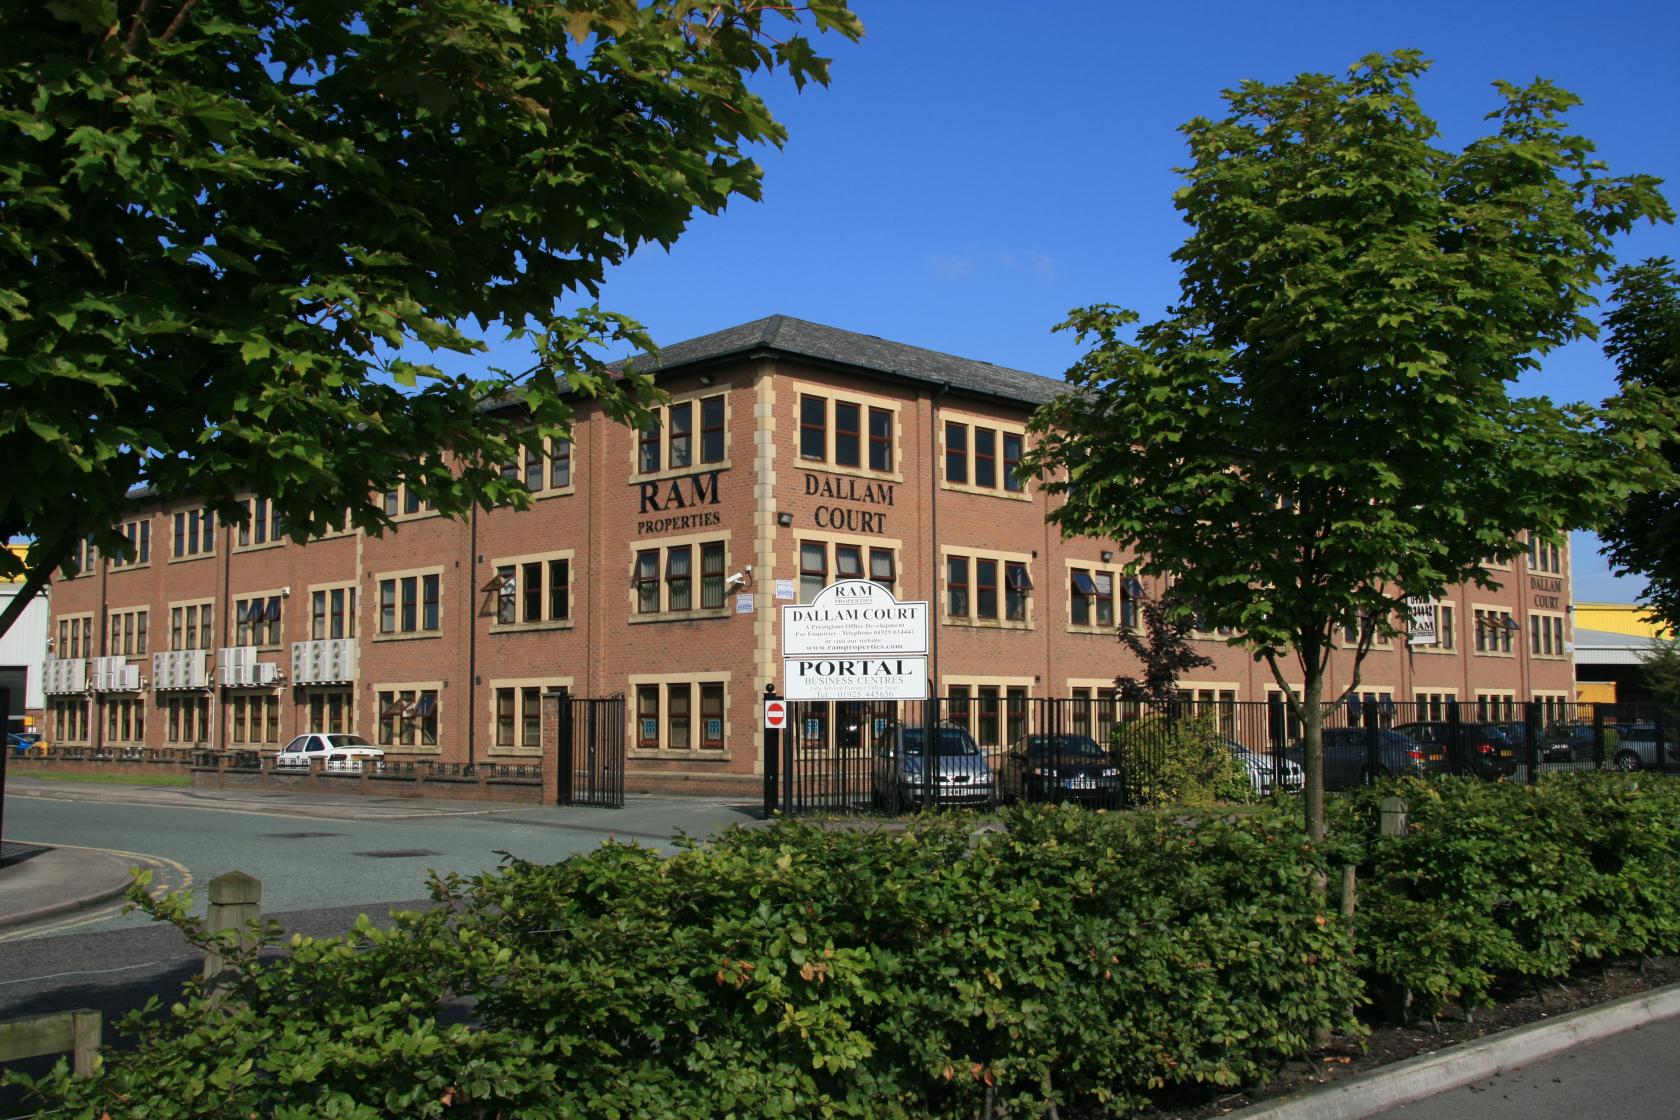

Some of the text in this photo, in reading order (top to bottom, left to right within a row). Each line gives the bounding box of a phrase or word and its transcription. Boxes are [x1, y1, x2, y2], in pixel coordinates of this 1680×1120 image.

[638, 471, 722, 514] RAM
[805, 473, 894, 506] DALLAM
[637, 511, 721, 534] PROPERTIES
[815, 505, 886, 534] COURT
[835, 585, 872, 596] RAM
[1530, 577, 1562, 592] DALLAM
[1535, 594, 1559, 609] COURT
[793, 607, 918, 622] DALLAM COURT
[842, 629, 872, 637] Telephone
[865, 622, 905, 630] Development
[1410, 621, 1434, 630] RAM
[806, 643, 904, 652] www.ramproperties.com
[799, 659, 913, 677] PORTAL
[805, 676, 904, 686] BUSINESS CENTRES
[837, 690, 861, 698] 01925
[865, 690, 894, 698] 445656
